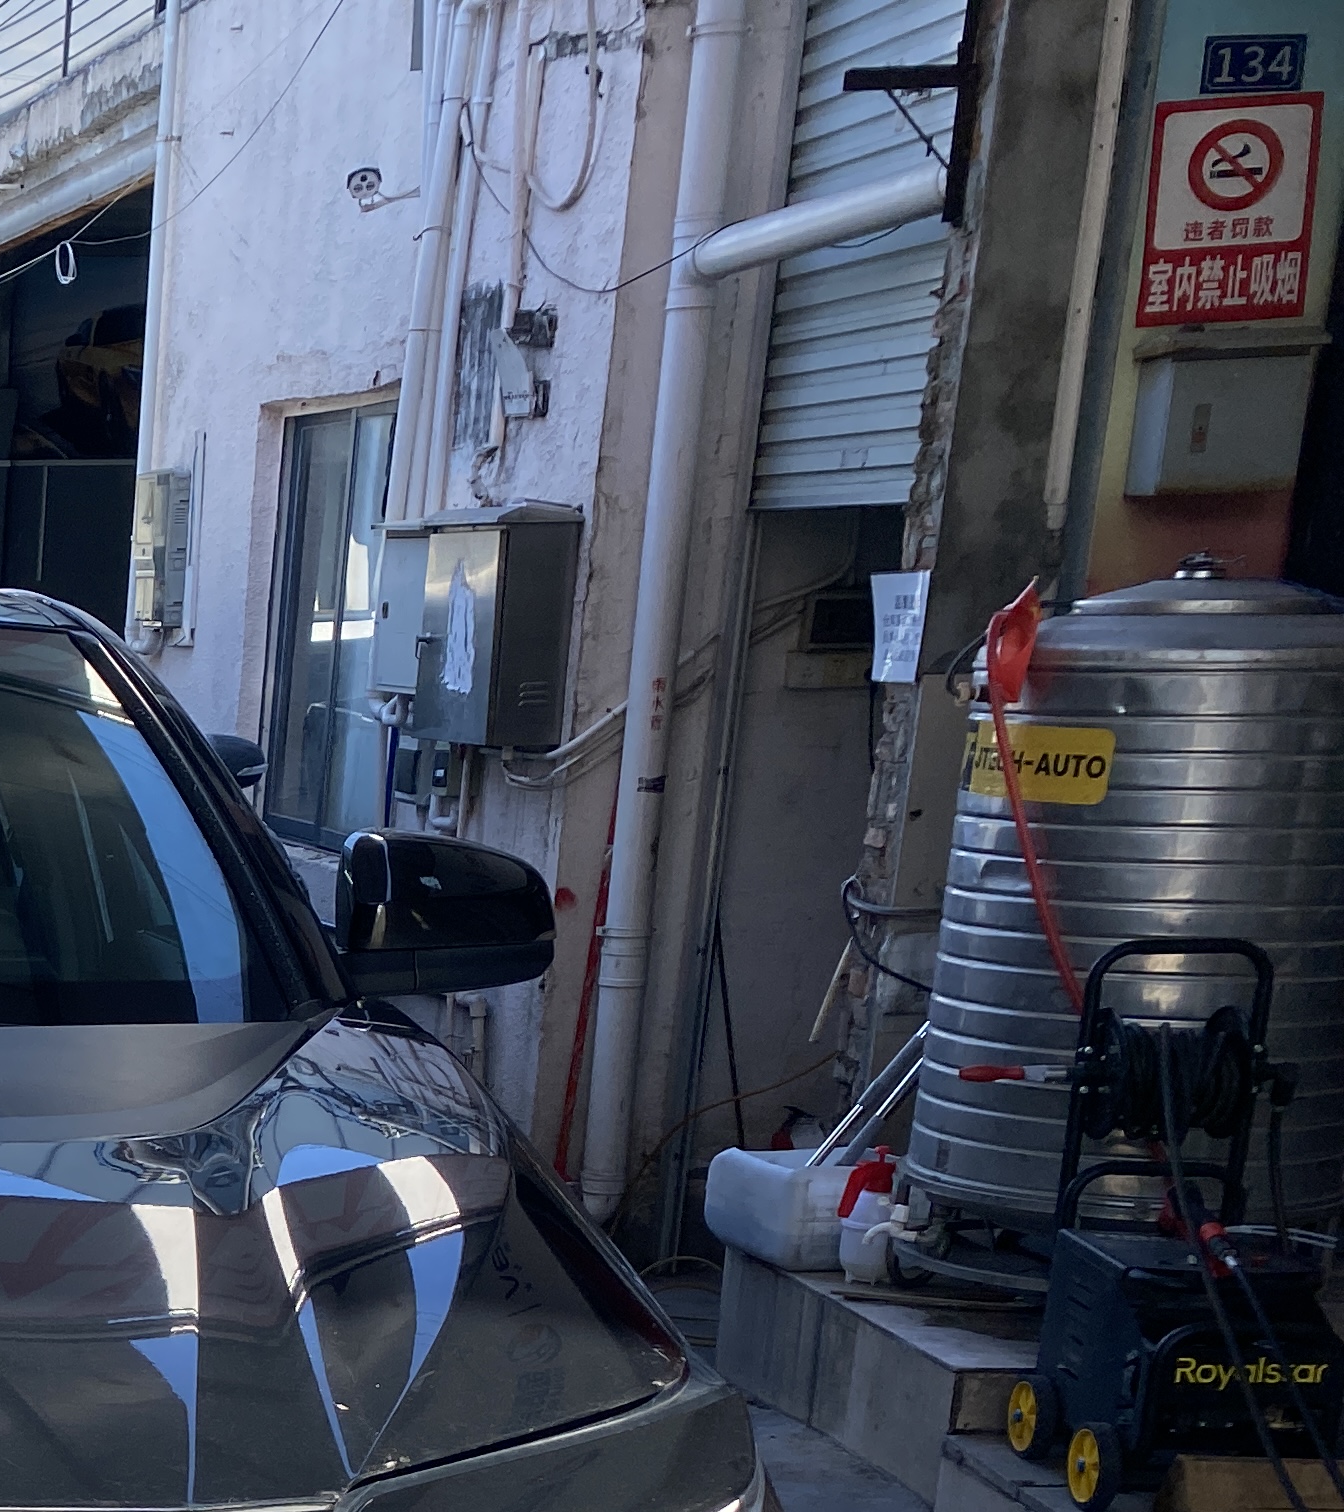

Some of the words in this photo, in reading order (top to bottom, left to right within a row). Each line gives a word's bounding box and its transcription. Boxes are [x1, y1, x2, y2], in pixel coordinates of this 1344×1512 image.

[1212, 45, 1294, 84] 134
[1183, 215, 1274, 243] 违者罚款
[1144, 251, 1303, 314] 室内禁止吸烟
